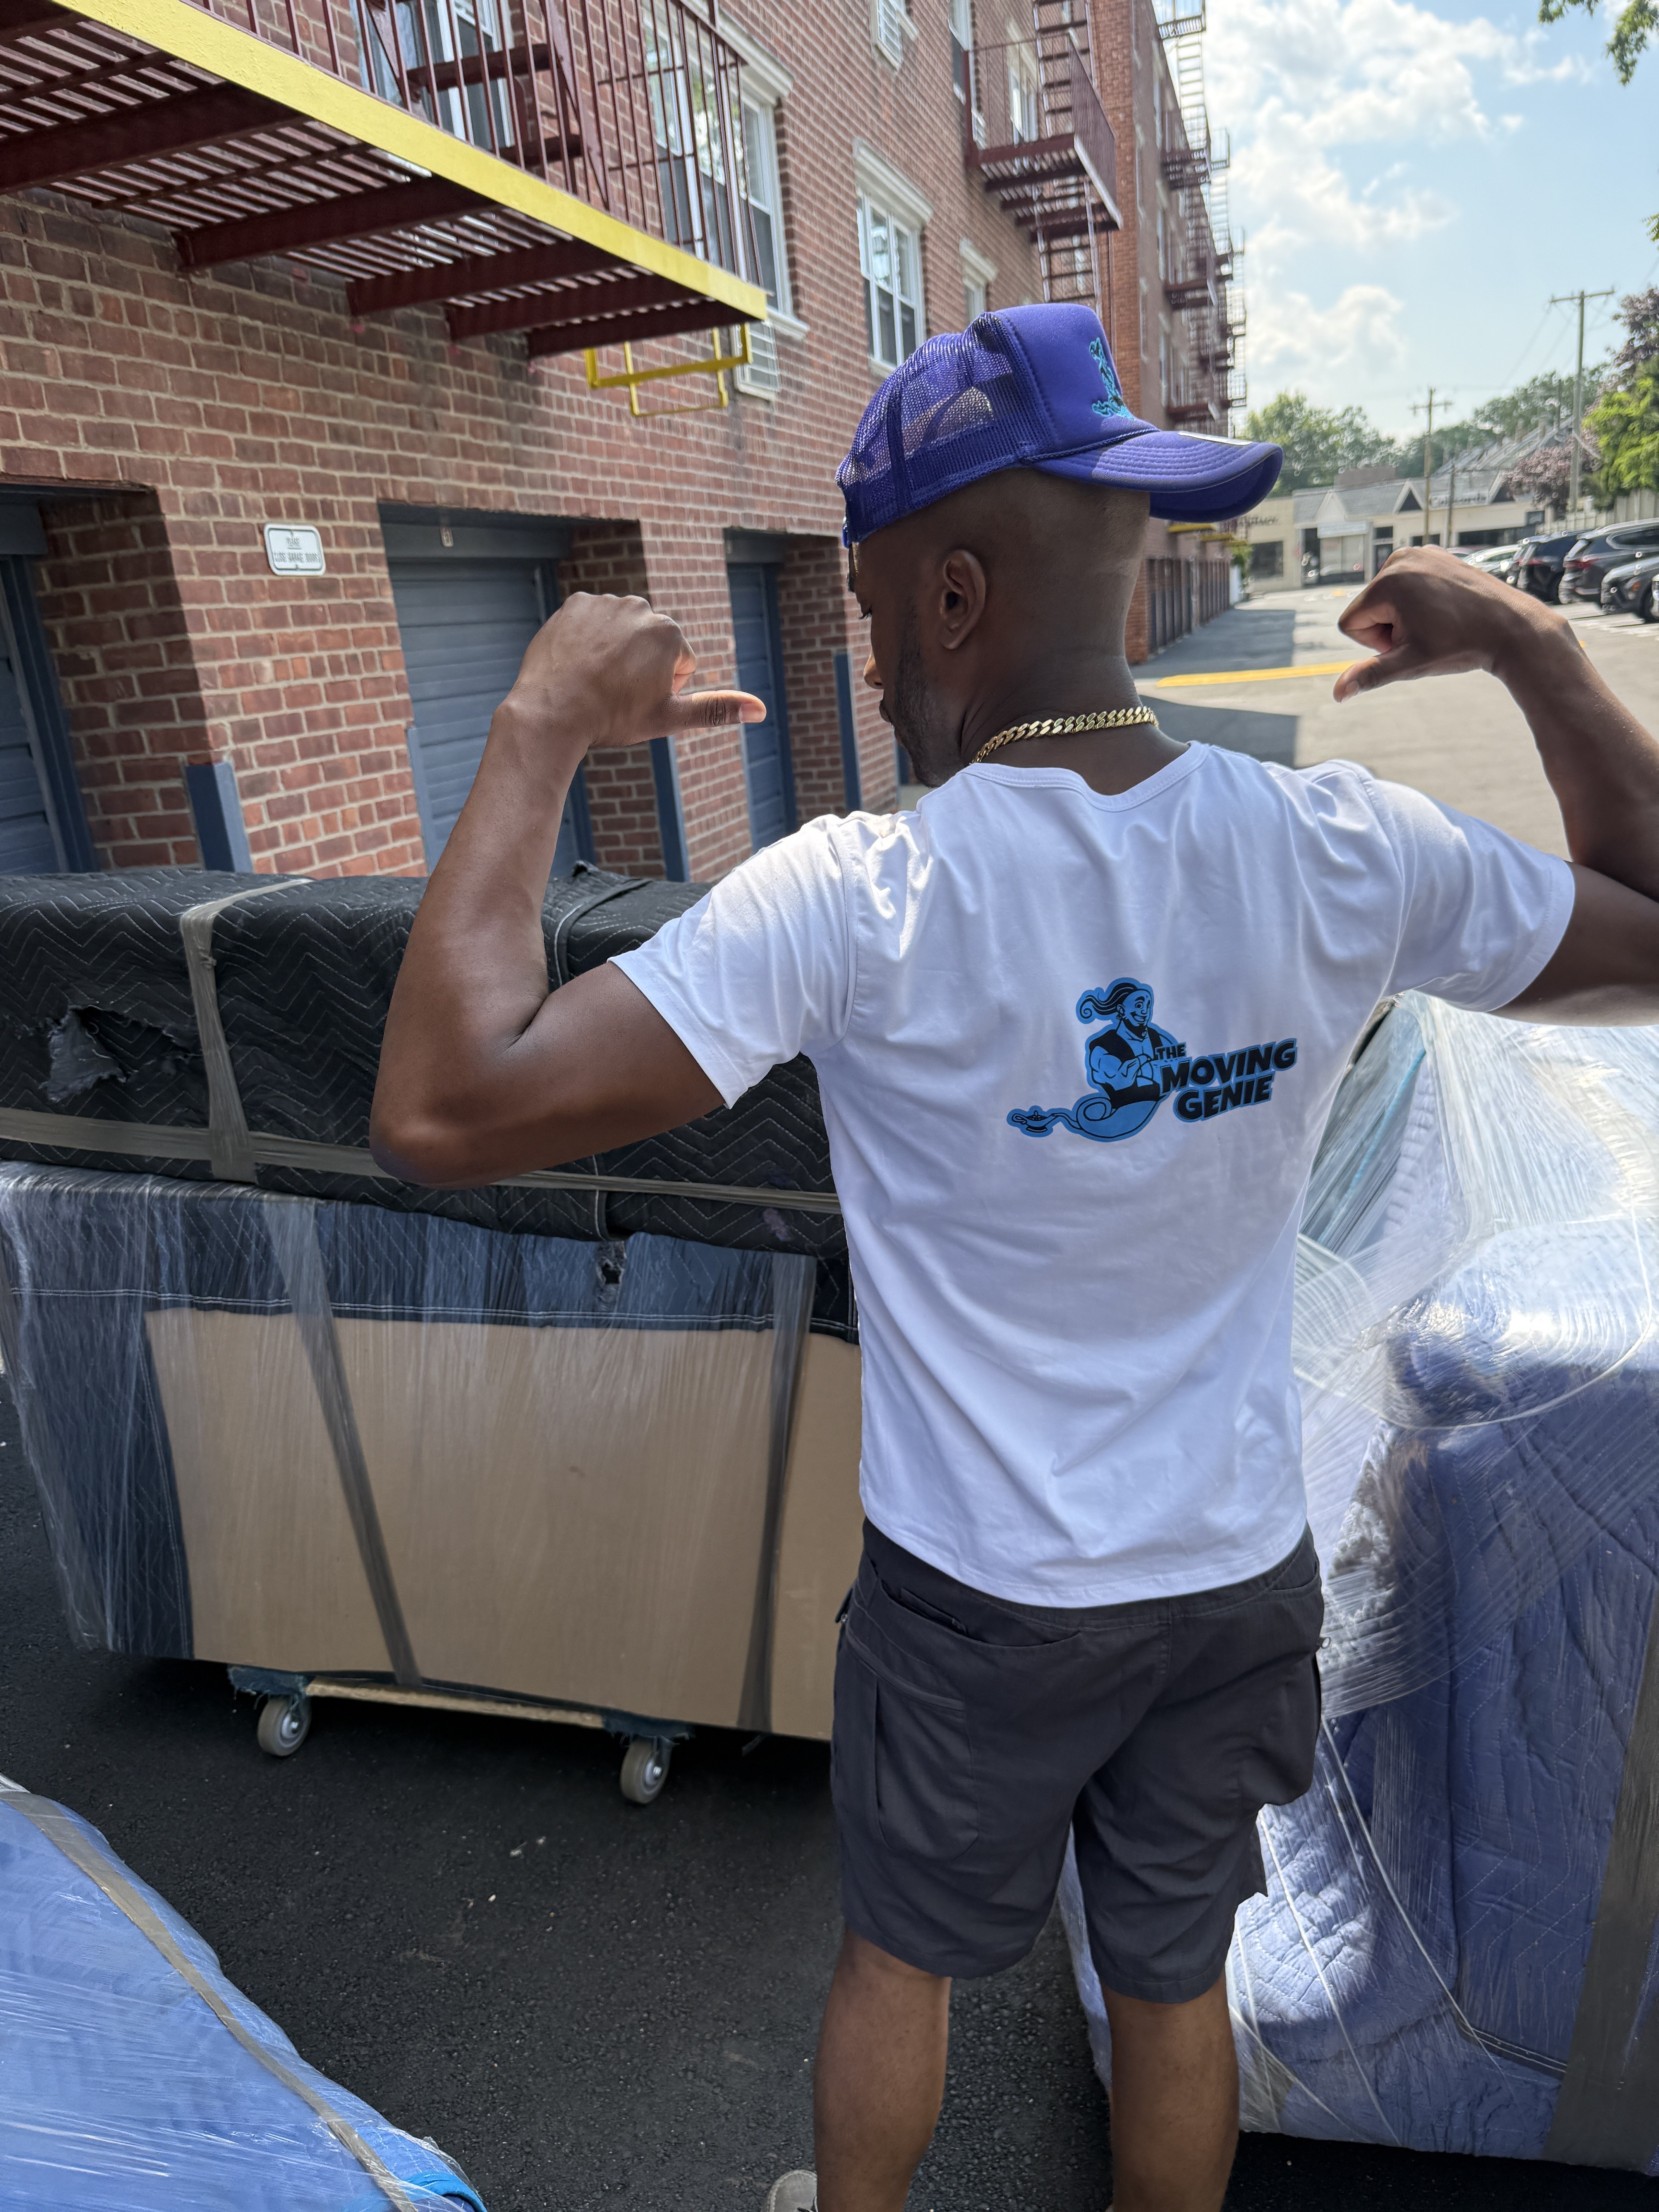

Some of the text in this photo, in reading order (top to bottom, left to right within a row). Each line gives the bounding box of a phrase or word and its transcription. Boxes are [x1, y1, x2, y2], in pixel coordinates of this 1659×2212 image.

[1157, 1044, 1186, 1059] THE
[1160, 1040, 1296, 1094] MOVING
[1176, 1073, 1273, 1120] GENIE
